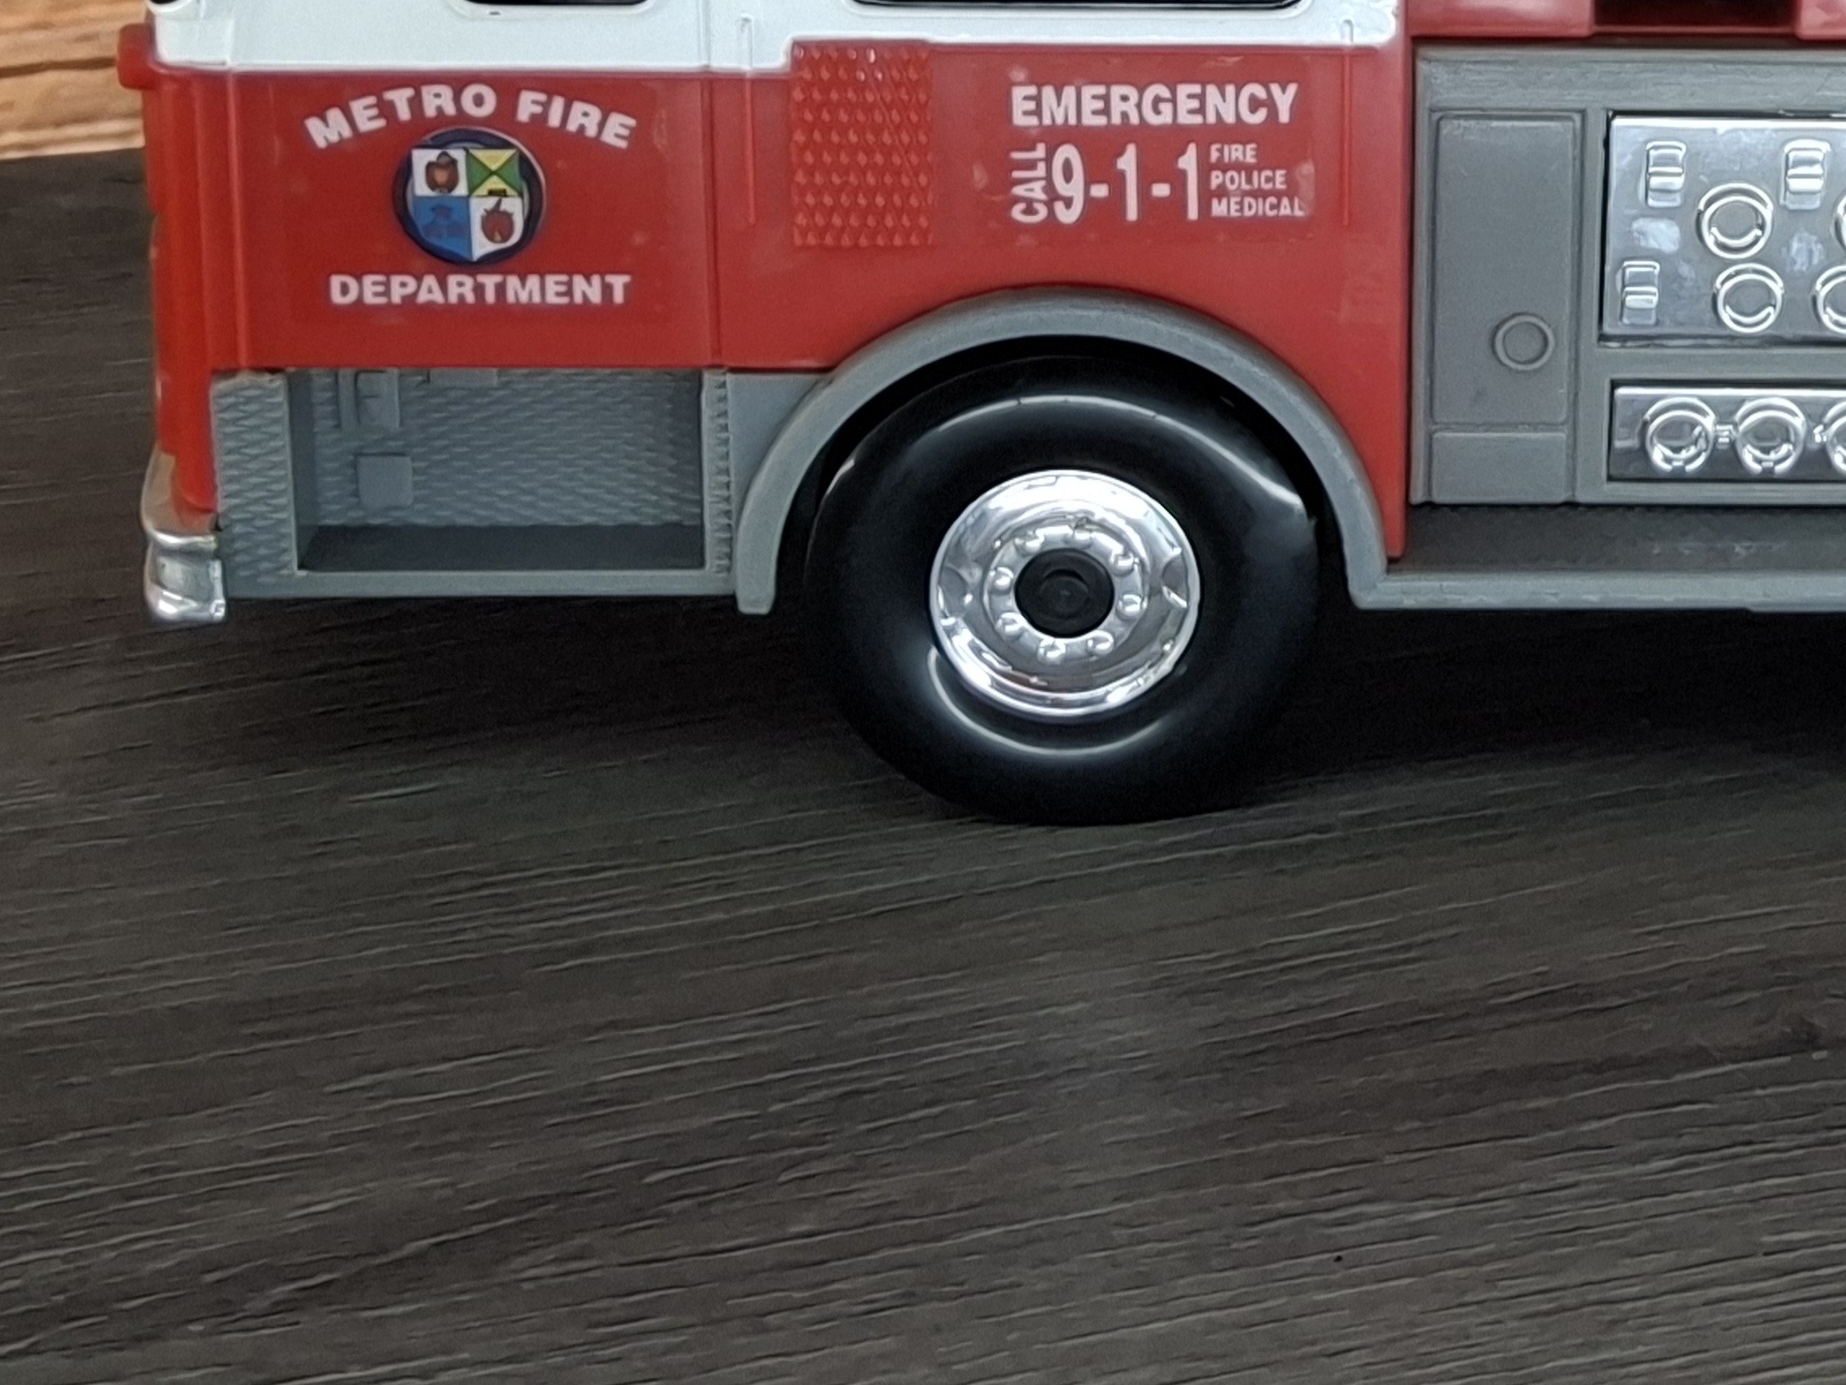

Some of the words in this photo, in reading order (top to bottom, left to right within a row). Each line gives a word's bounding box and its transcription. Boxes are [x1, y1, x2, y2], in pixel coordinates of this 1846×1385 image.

[303, 83, 497, 149] METRO
[515, 89, 638, 150] FIRE
[1010, 82, 1299, 127] EMERGENCY
[1209, 142, 1258, 164] FIRE
[1009, 141, 1049, 225] CALL
[1051, 141, 1199, 225] 9-1-1
[1209, 168, 1288, 191] POLICE
[1210, 195, 1306, 218] MEDICAL
[329, 273, 632, 306] DEPARTMENT
